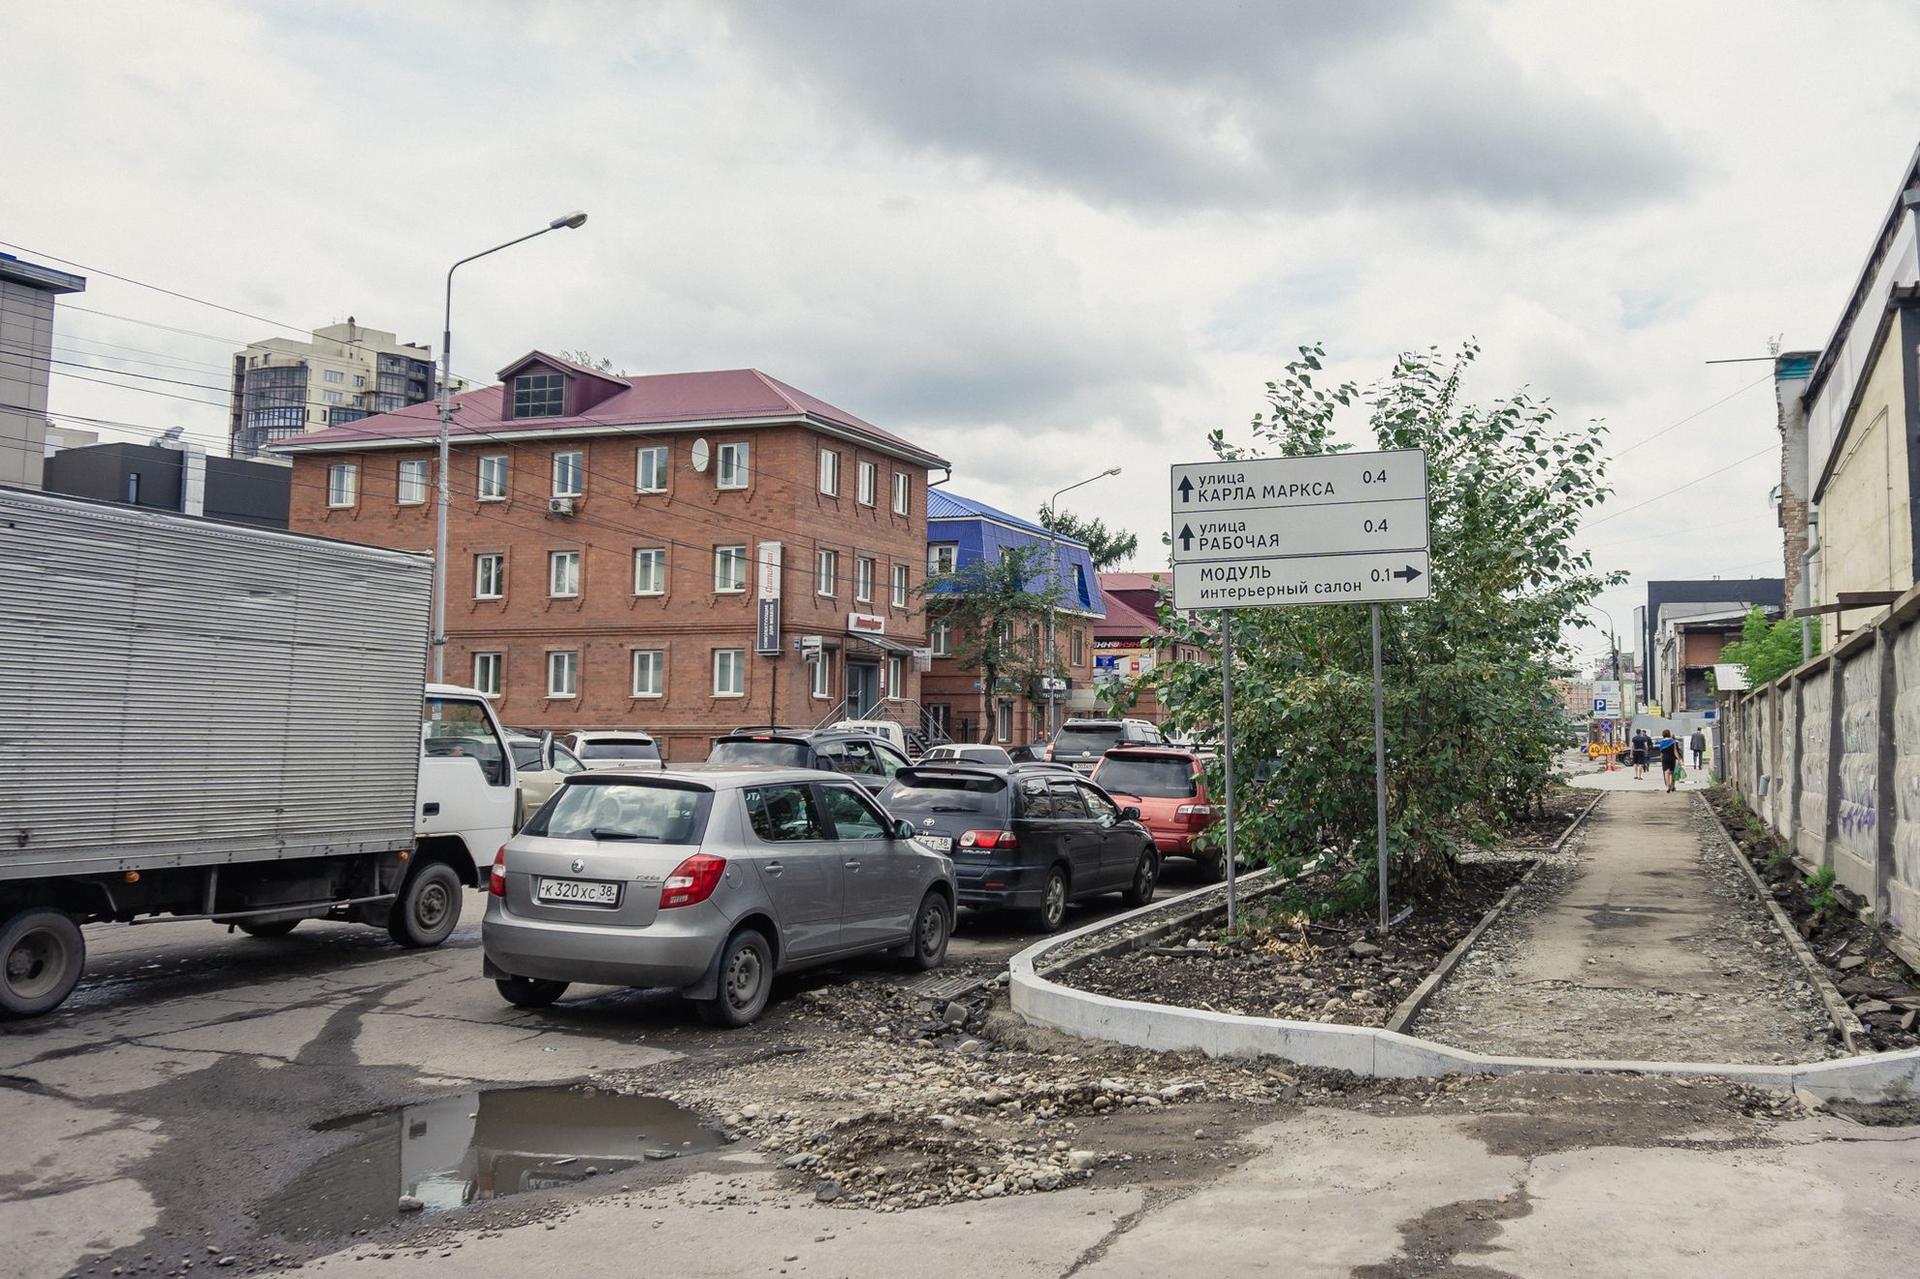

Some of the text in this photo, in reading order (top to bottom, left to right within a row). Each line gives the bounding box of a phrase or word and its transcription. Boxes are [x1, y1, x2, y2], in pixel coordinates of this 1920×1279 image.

[1198, 473, 1245, 488] улица
[1362, 469, 1387, 484] 0.4
[1198, 481, 1335, 503] КАРЛА МАРКСА
[1199, 521, 1247, 537] улица
[1363, 518, 1389, 533] 0.4
[1199, 533, 1280, 551] РАБОЧАЯ
[1200, 565, 1272, 583] МОДУЛЬ
[1370, 567, 1391, 583] 0.1
[1200, 580, 1362, 600] интерьерный салон
